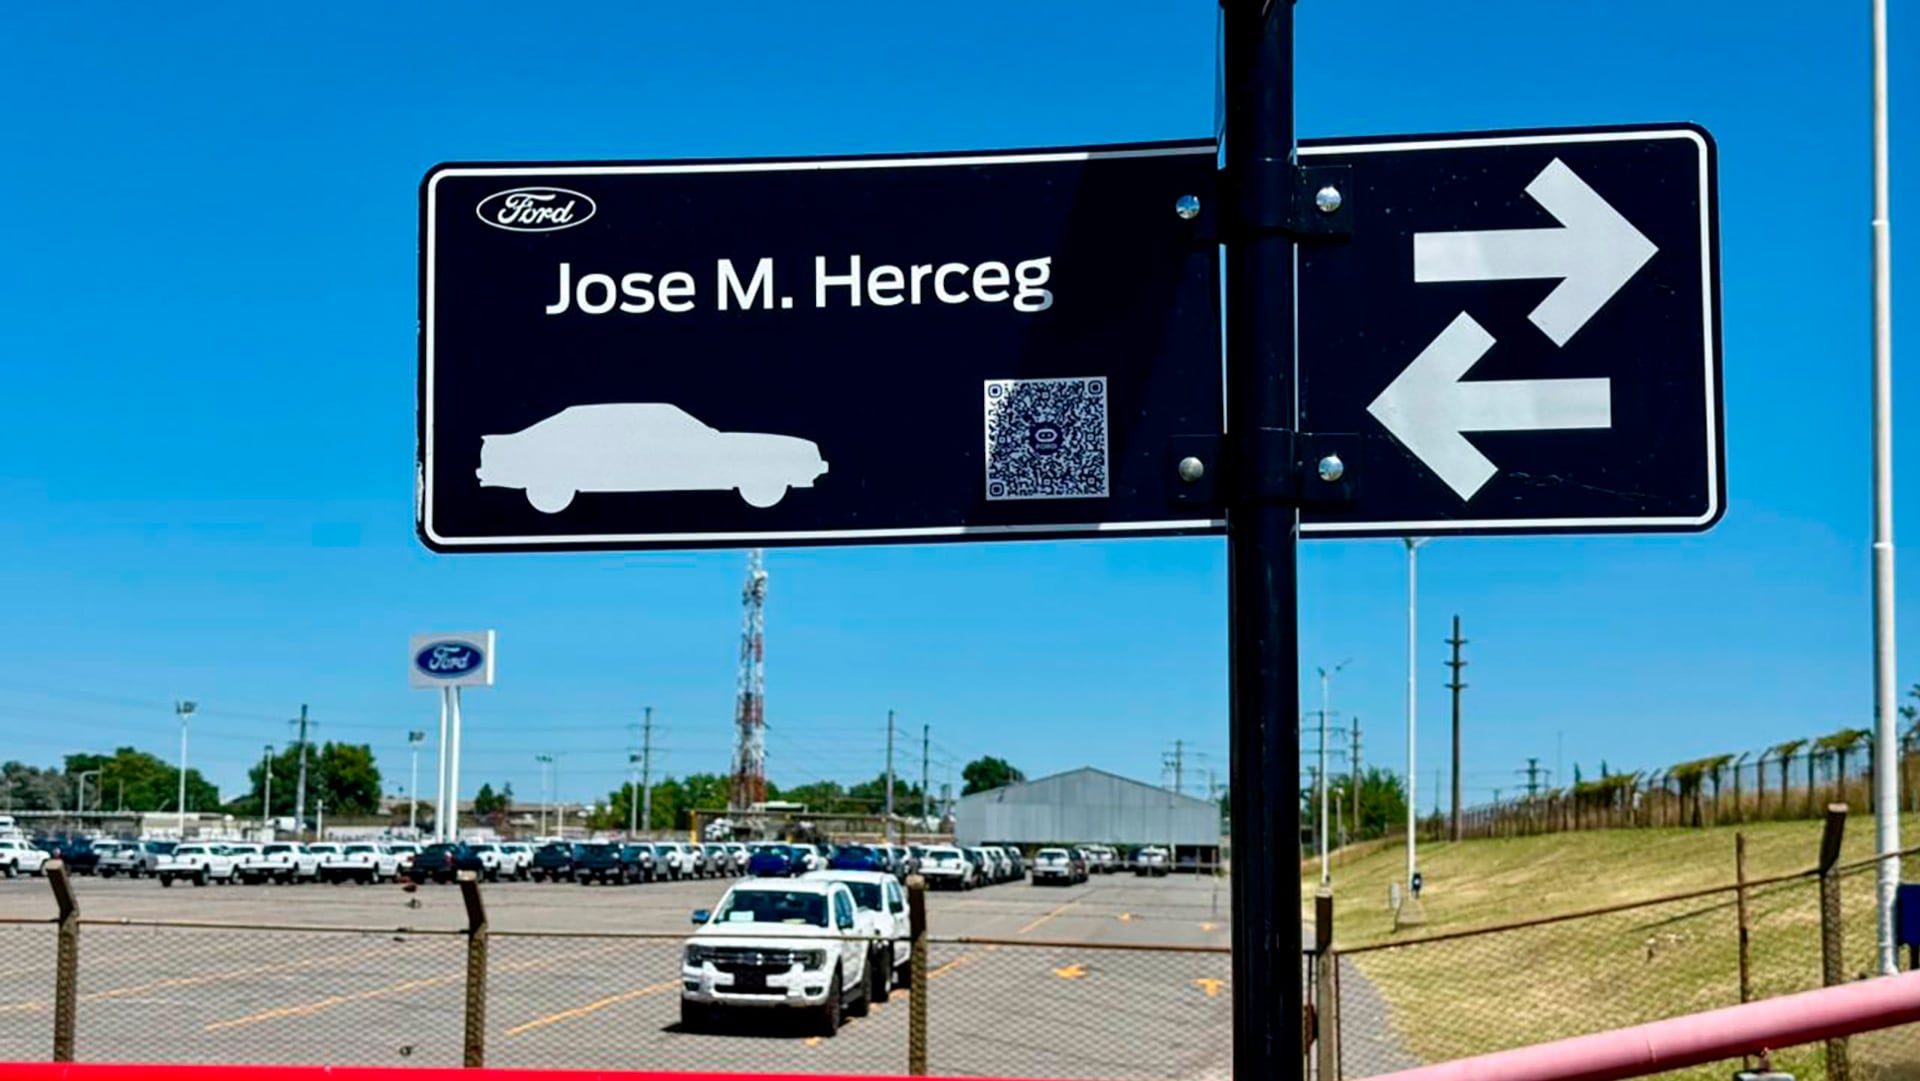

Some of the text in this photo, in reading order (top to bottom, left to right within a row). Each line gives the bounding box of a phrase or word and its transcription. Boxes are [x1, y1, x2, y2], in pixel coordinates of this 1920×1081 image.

[497, 193, 576, 226] Ford
[545, 255, 1054, 315] Jose M. Herceg
[430, 647, 471, 670] Ford
